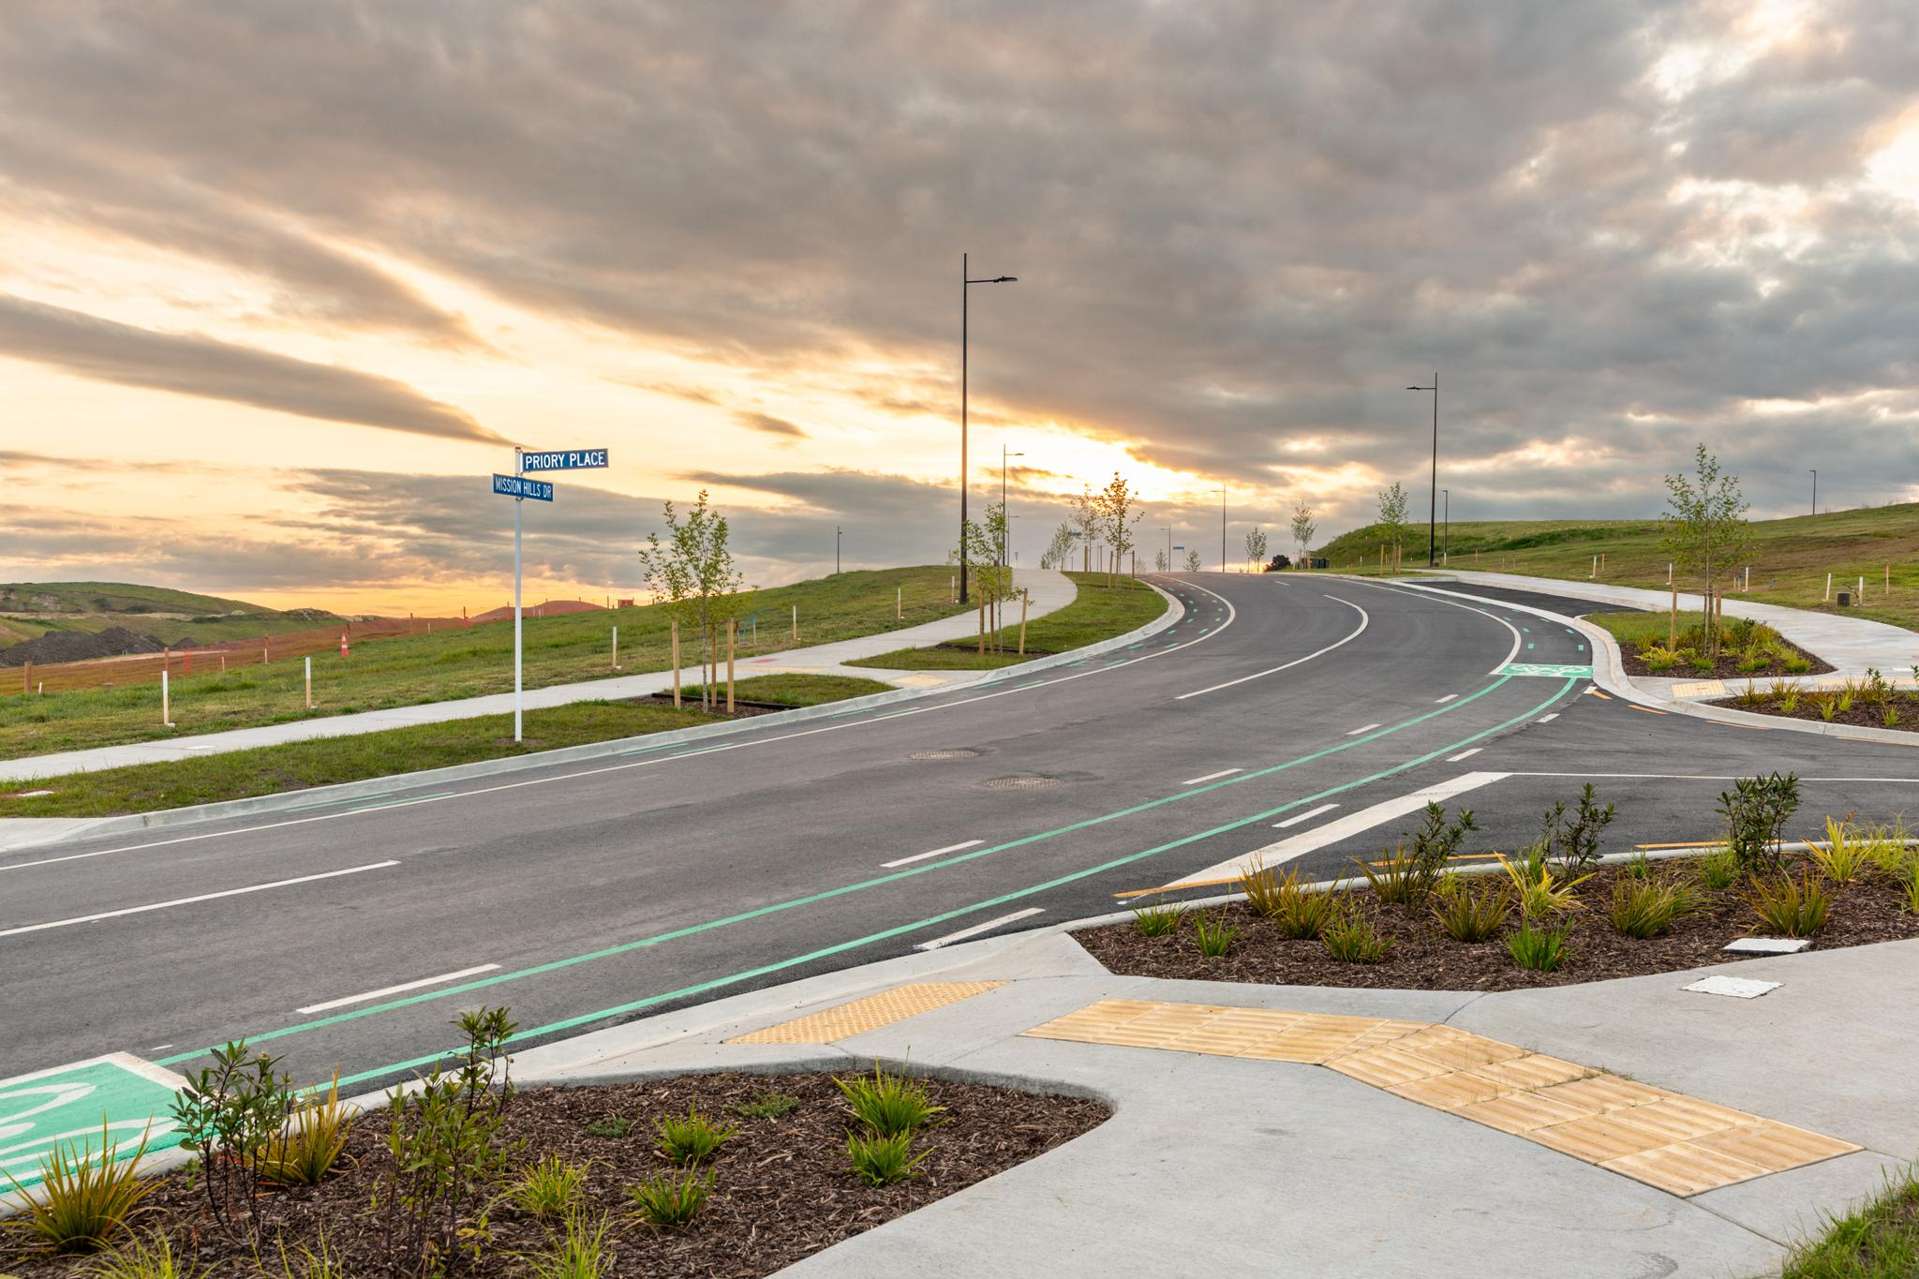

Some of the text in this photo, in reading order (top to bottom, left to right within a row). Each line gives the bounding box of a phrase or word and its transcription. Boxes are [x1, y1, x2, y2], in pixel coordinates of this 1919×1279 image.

[525, 452, 605, 469] PRIORY PLACE
[495, 477, 552, 498] MISSION HILLS DR
